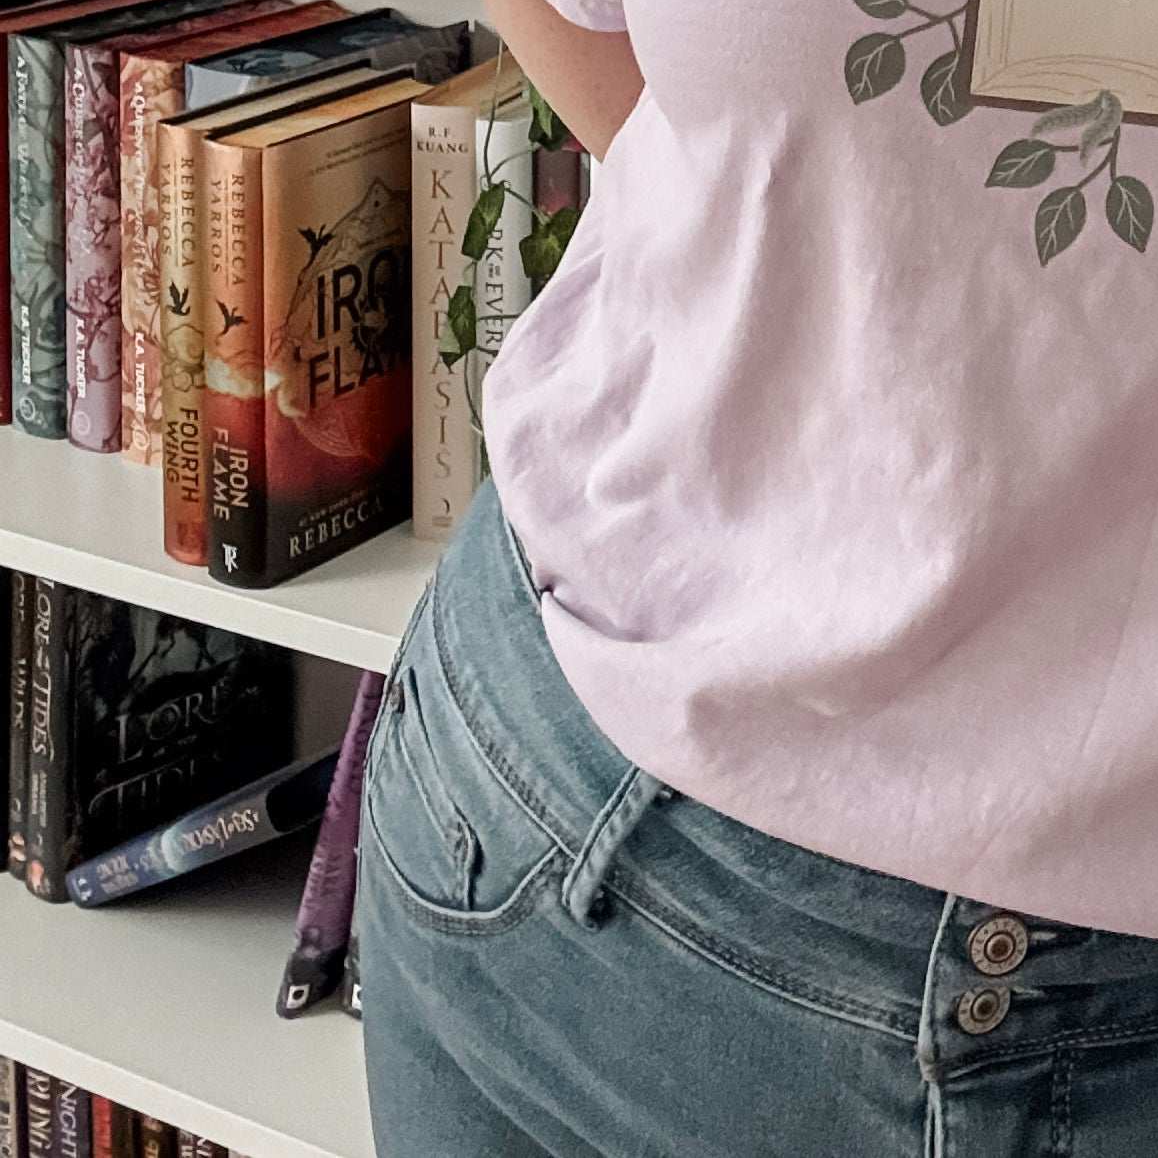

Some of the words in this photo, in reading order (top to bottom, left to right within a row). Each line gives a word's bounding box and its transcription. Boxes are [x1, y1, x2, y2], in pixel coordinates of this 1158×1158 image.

[416, 141, 469, 154] KUANG
[161, 163, 172, 255] YARROS
[180, 157, 196, 267] REBECCA
[210, 181, 222, 273] YARROS
[231, 173, 247, 285] REBECCA
[135, 362, 146, 413] TUCKER
[166, 421, 180, 483] WING
[179, 407, 199, 503] FOURTH
[212, 426, 230, 522] FLAME
[228, 447, 249, 509] IRON
[32, 671, 54, 757] TIDES
